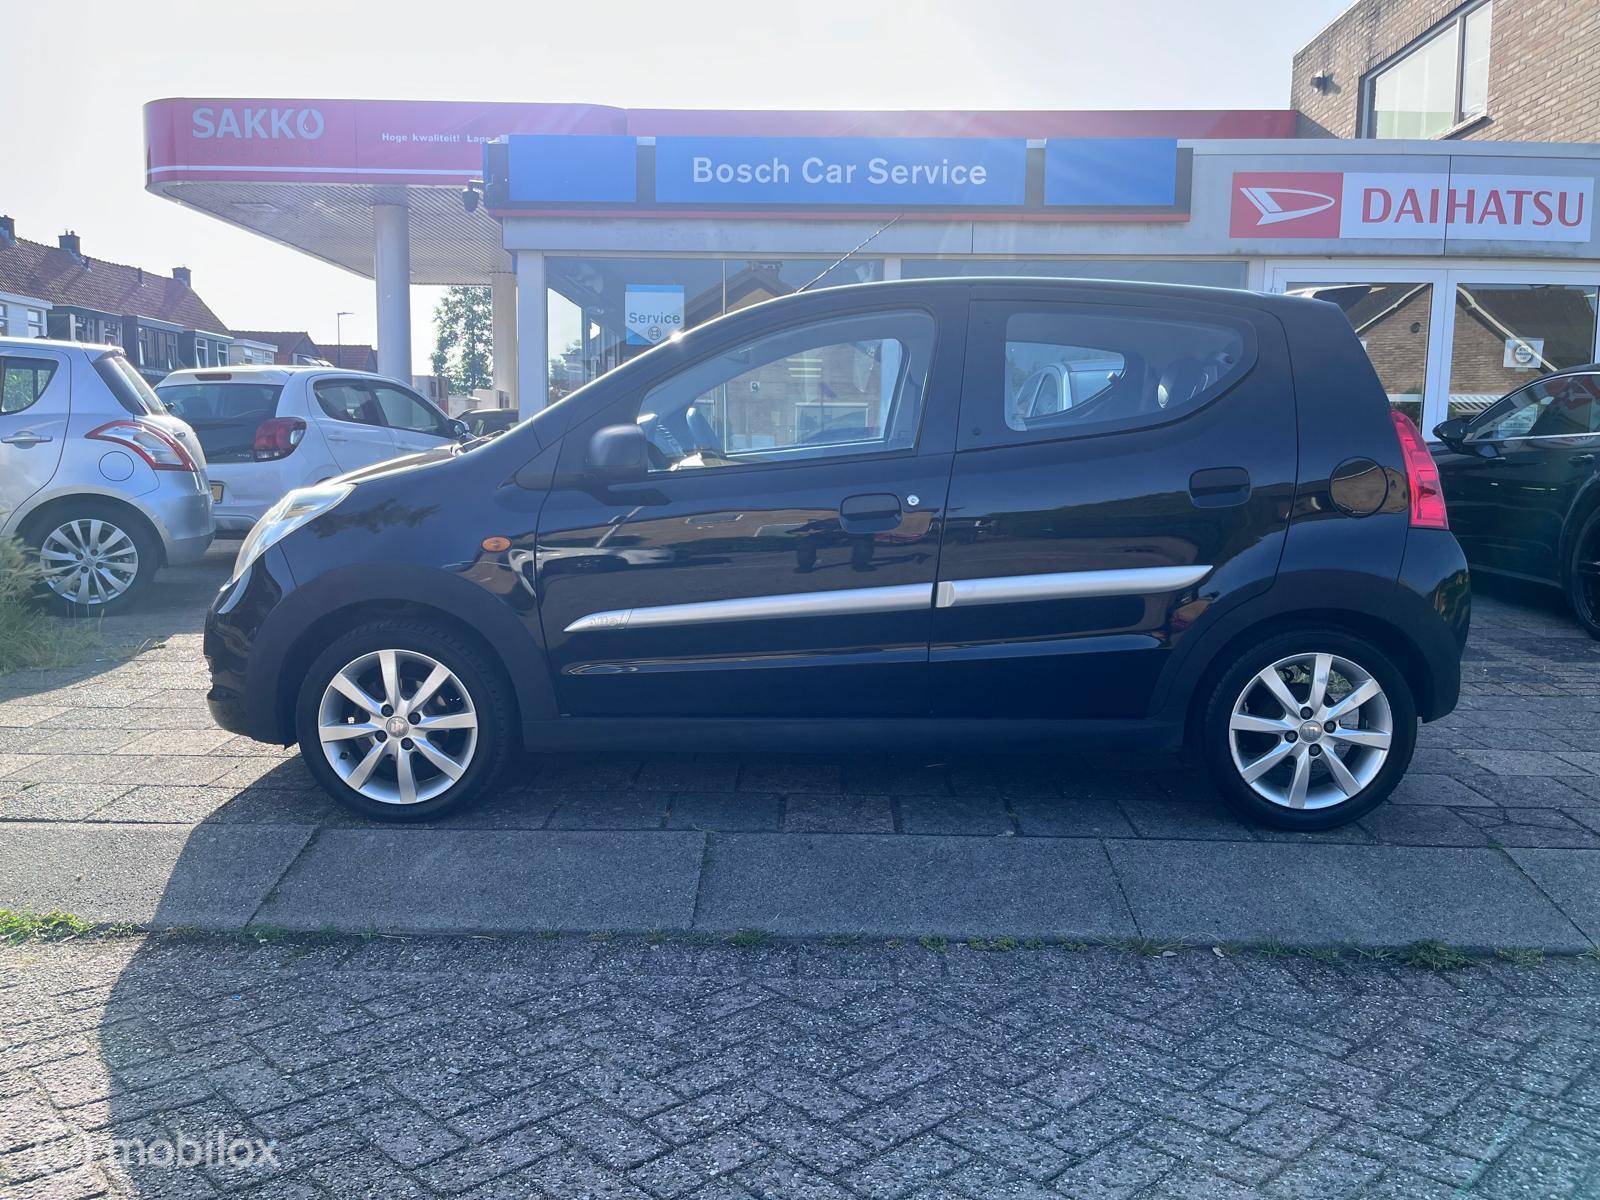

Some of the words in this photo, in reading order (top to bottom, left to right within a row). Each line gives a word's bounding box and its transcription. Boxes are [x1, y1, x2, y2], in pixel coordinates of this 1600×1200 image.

[191, 107, 325, 141] SAKKO
[382, 133, 408, 143] Hoge
[412, 133, 460, 143] kwaliteit!
[692, 156, 790, 184] Bosch
[801, 157, 857, 184] Car
[867, 158, 987, 185] Service
[1362, 188, 1584, 226] DAIHATSU
[628, 311, 681, 325] Service
